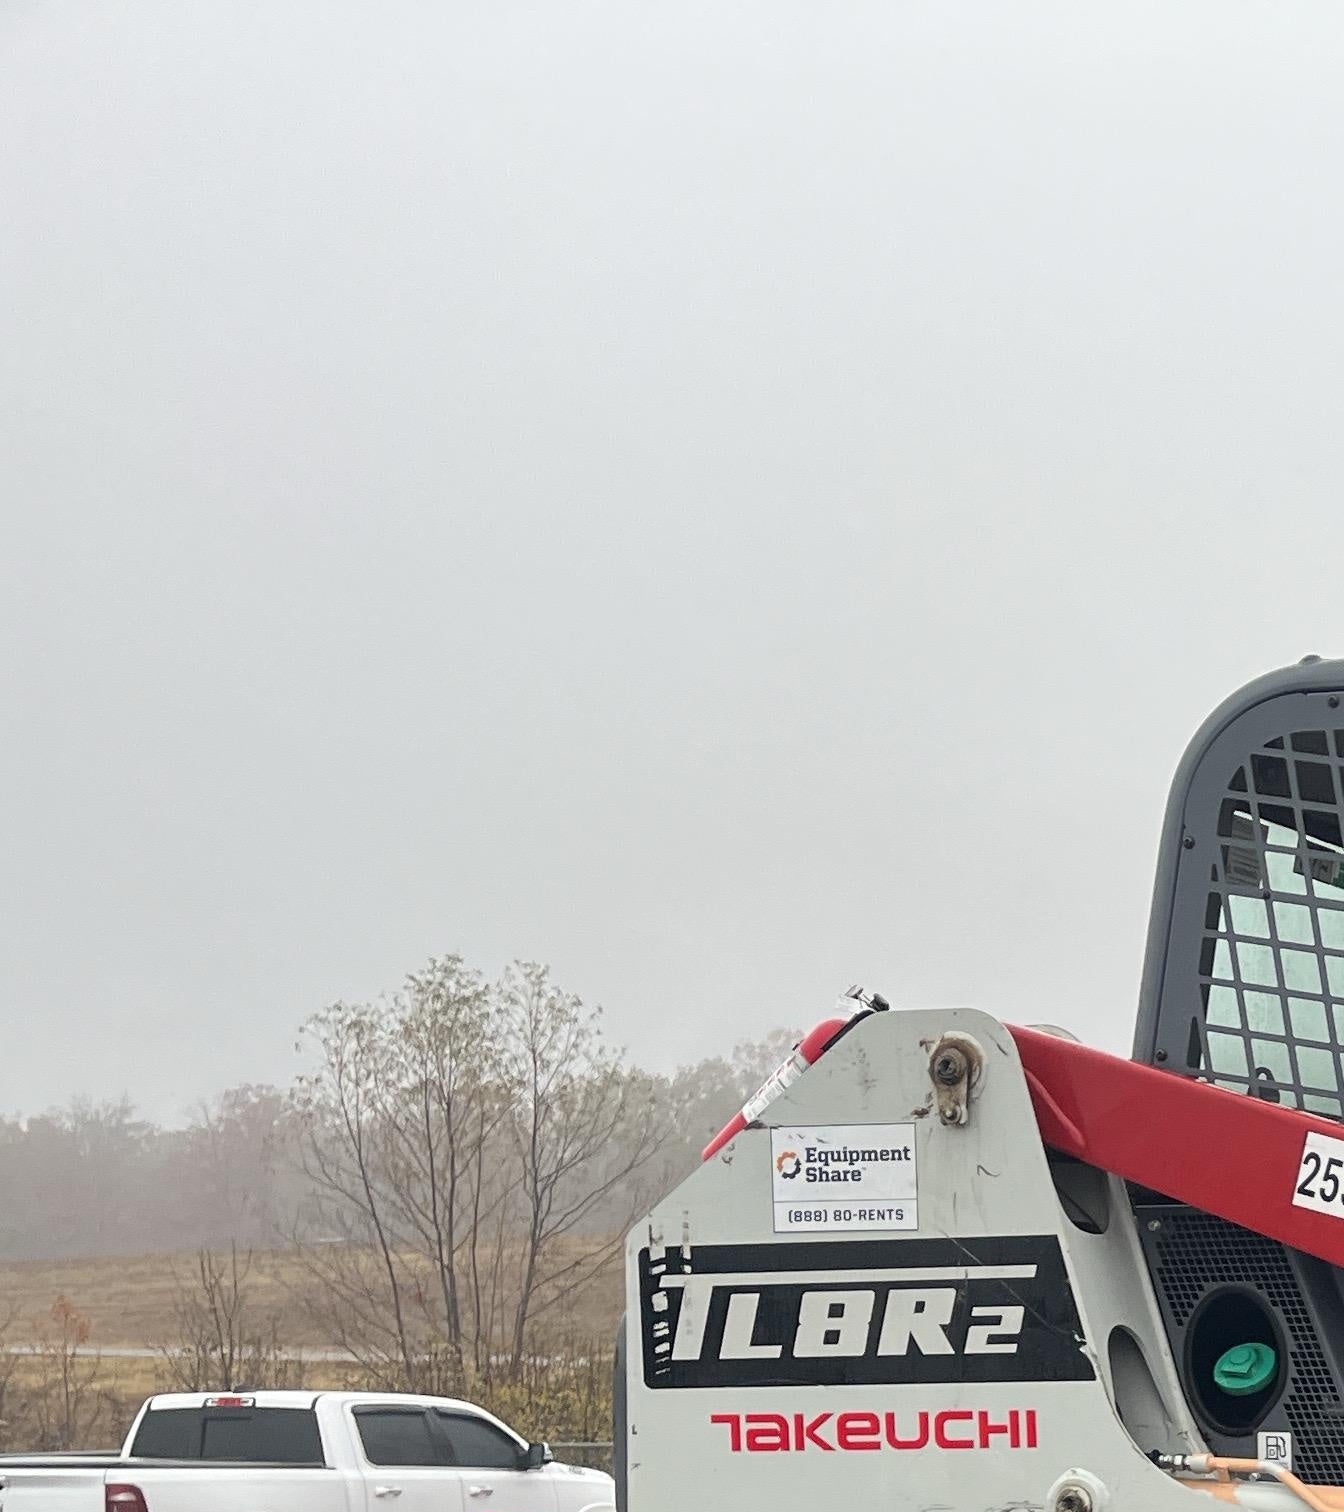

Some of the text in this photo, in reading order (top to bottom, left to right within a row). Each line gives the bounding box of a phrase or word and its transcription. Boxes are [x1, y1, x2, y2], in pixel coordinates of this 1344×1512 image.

[804, 1145, 912, 1167] Equipment
[805, 1166, 863, 1183] Share
[788, 1208, 905, 1224] (888) 80-RENTS
[710, 1408, 1039, 1452] TAKEUCHI
